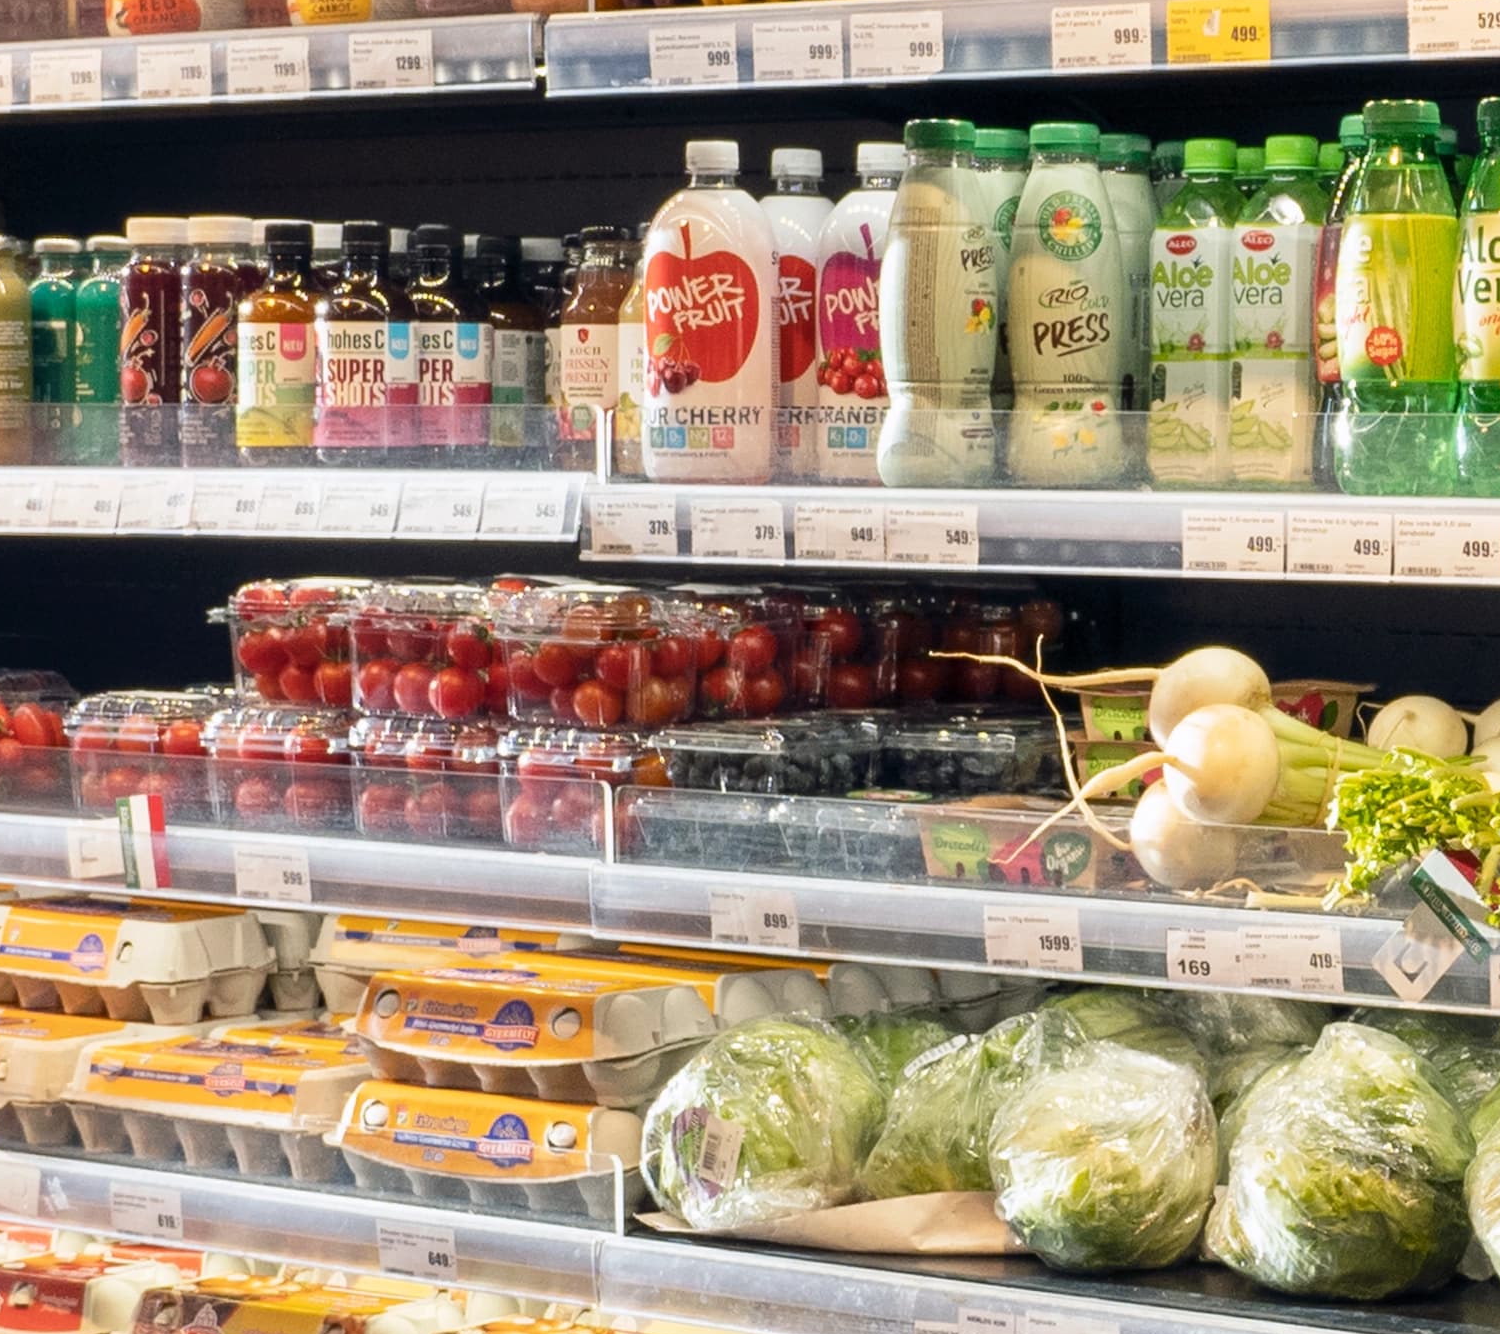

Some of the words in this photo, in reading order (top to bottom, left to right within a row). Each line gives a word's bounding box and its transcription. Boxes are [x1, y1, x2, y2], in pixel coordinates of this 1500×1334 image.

[1152, 257, 1214, 288] Aloe
[1232, 255, 1291, 286] Aloe
[647, 272, 745, 324] POWER
[673, 293, 745, 328] FRUIT
[1157, 290, 1204, 309] vera
[1231, 288, 1283, 307] vera
[1034, 312, 1111, 356] PRESS
[327, 358, 386, 386] SUPER
[674, 406, 765, 426] CHERRY
[1178, 959, 1211, 978] 169
